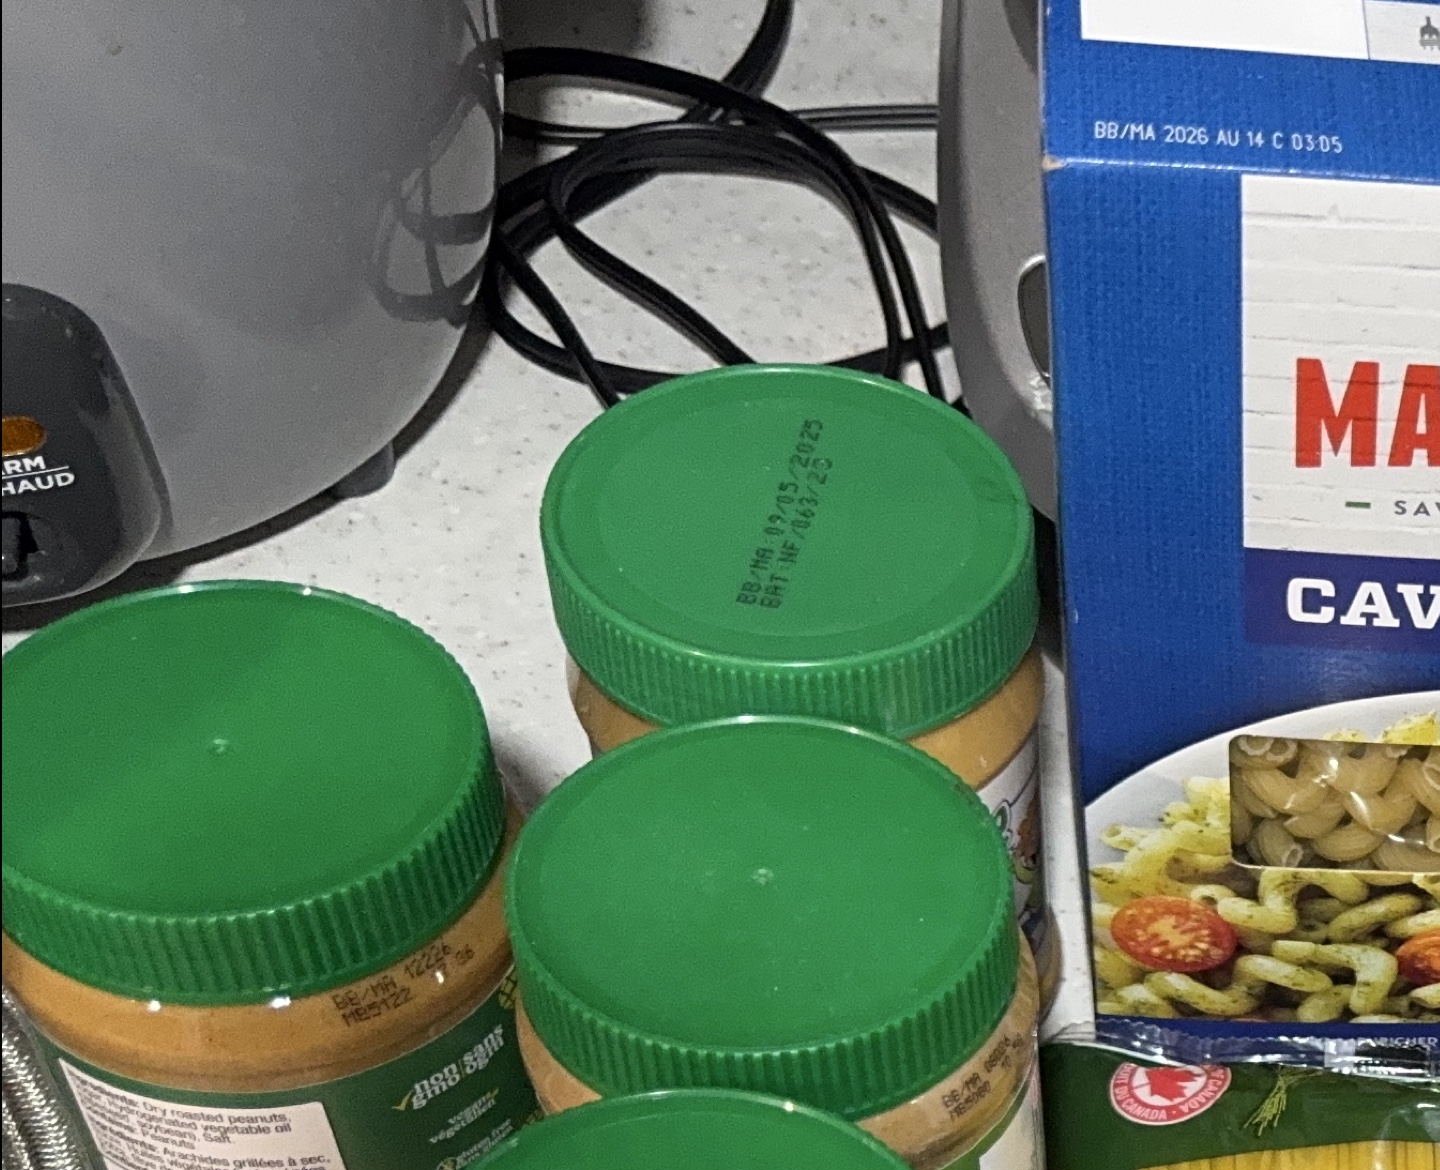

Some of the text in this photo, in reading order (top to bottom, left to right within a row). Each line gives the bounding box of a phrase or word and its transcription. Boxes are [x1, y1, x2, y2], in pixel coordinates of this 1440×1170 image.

[1094, 121, 1240, 147] BB/MA 2026 AU
[2, 456, 46, 475] RM
[414, 1063, 458, 1095] non
[412, 1074, 460, 1110] gmo
[171, 1108, 223, 1123] roasted
[228, 1112, 292, 1126] peanuts,
[202, 1122, 292, 1136] vegetable oil
